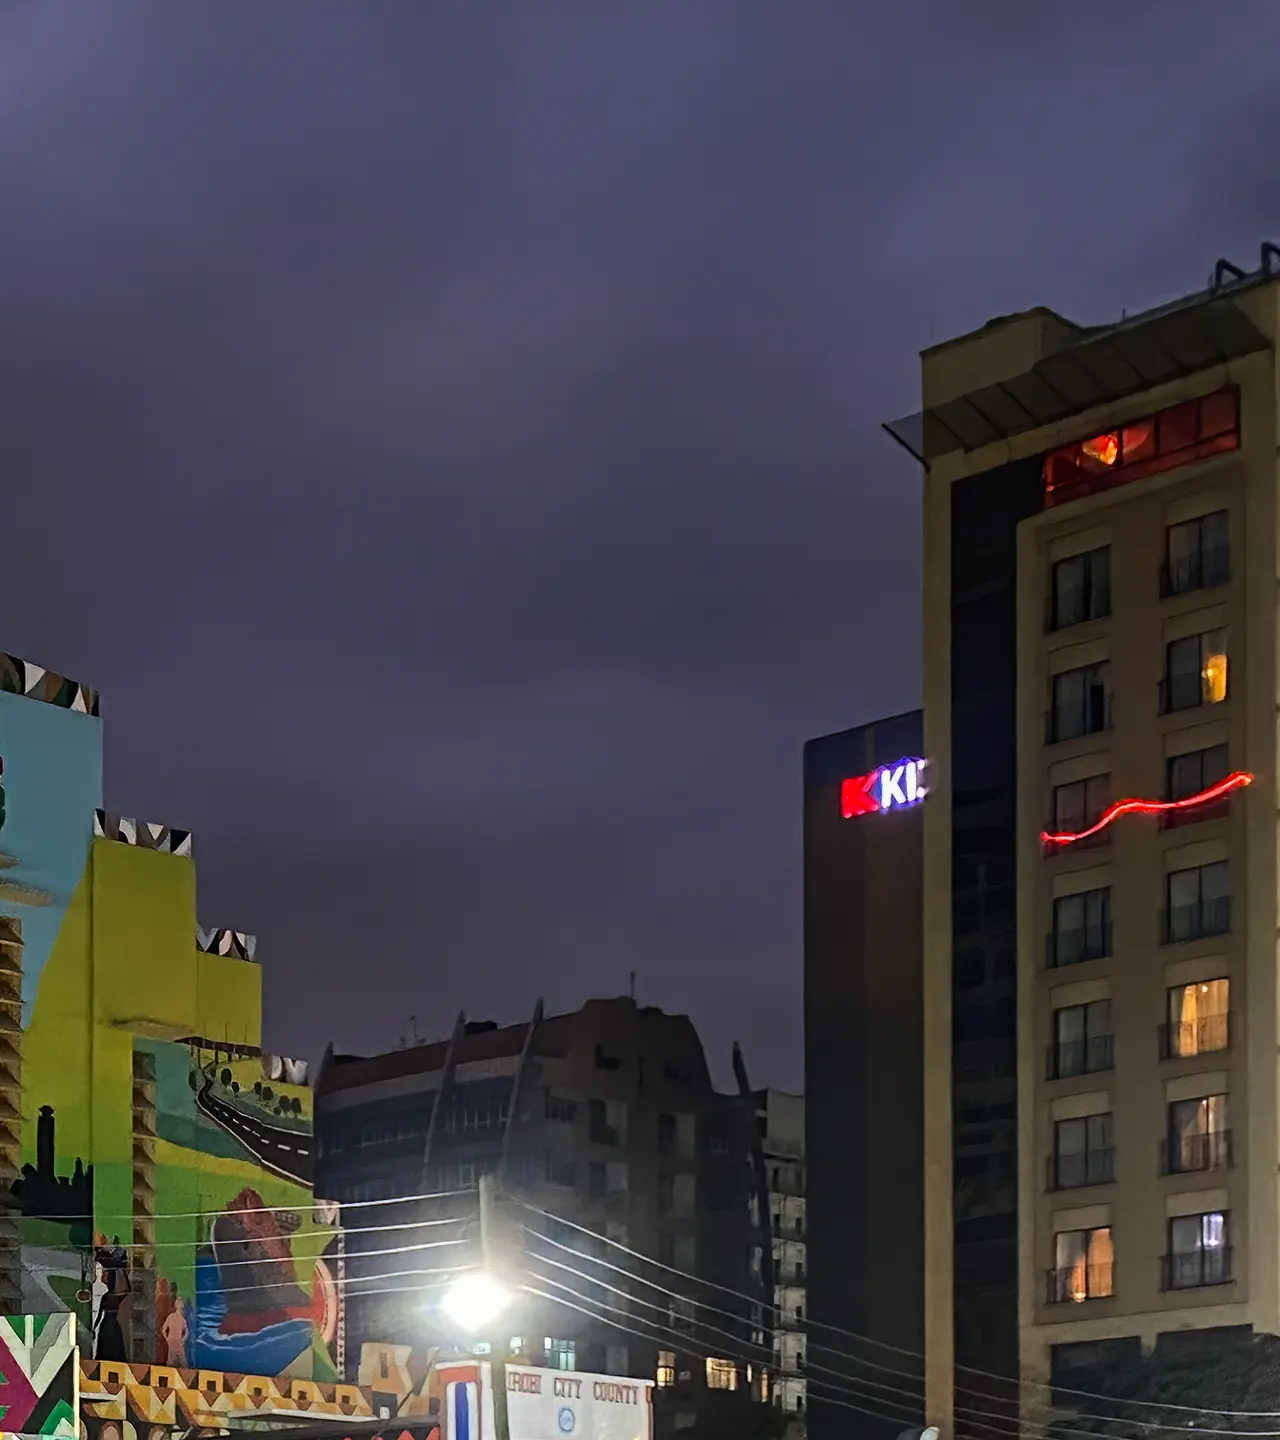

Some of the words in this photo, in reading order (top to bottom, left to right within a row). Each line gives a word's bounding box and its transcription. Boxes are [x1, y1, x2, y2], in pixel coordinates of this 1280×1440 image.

[508, 1371, 542, 1395] IROBI
[553, 1377, 582, 1399] CITY
[593, 1381, 639, 1405] COUNTY
